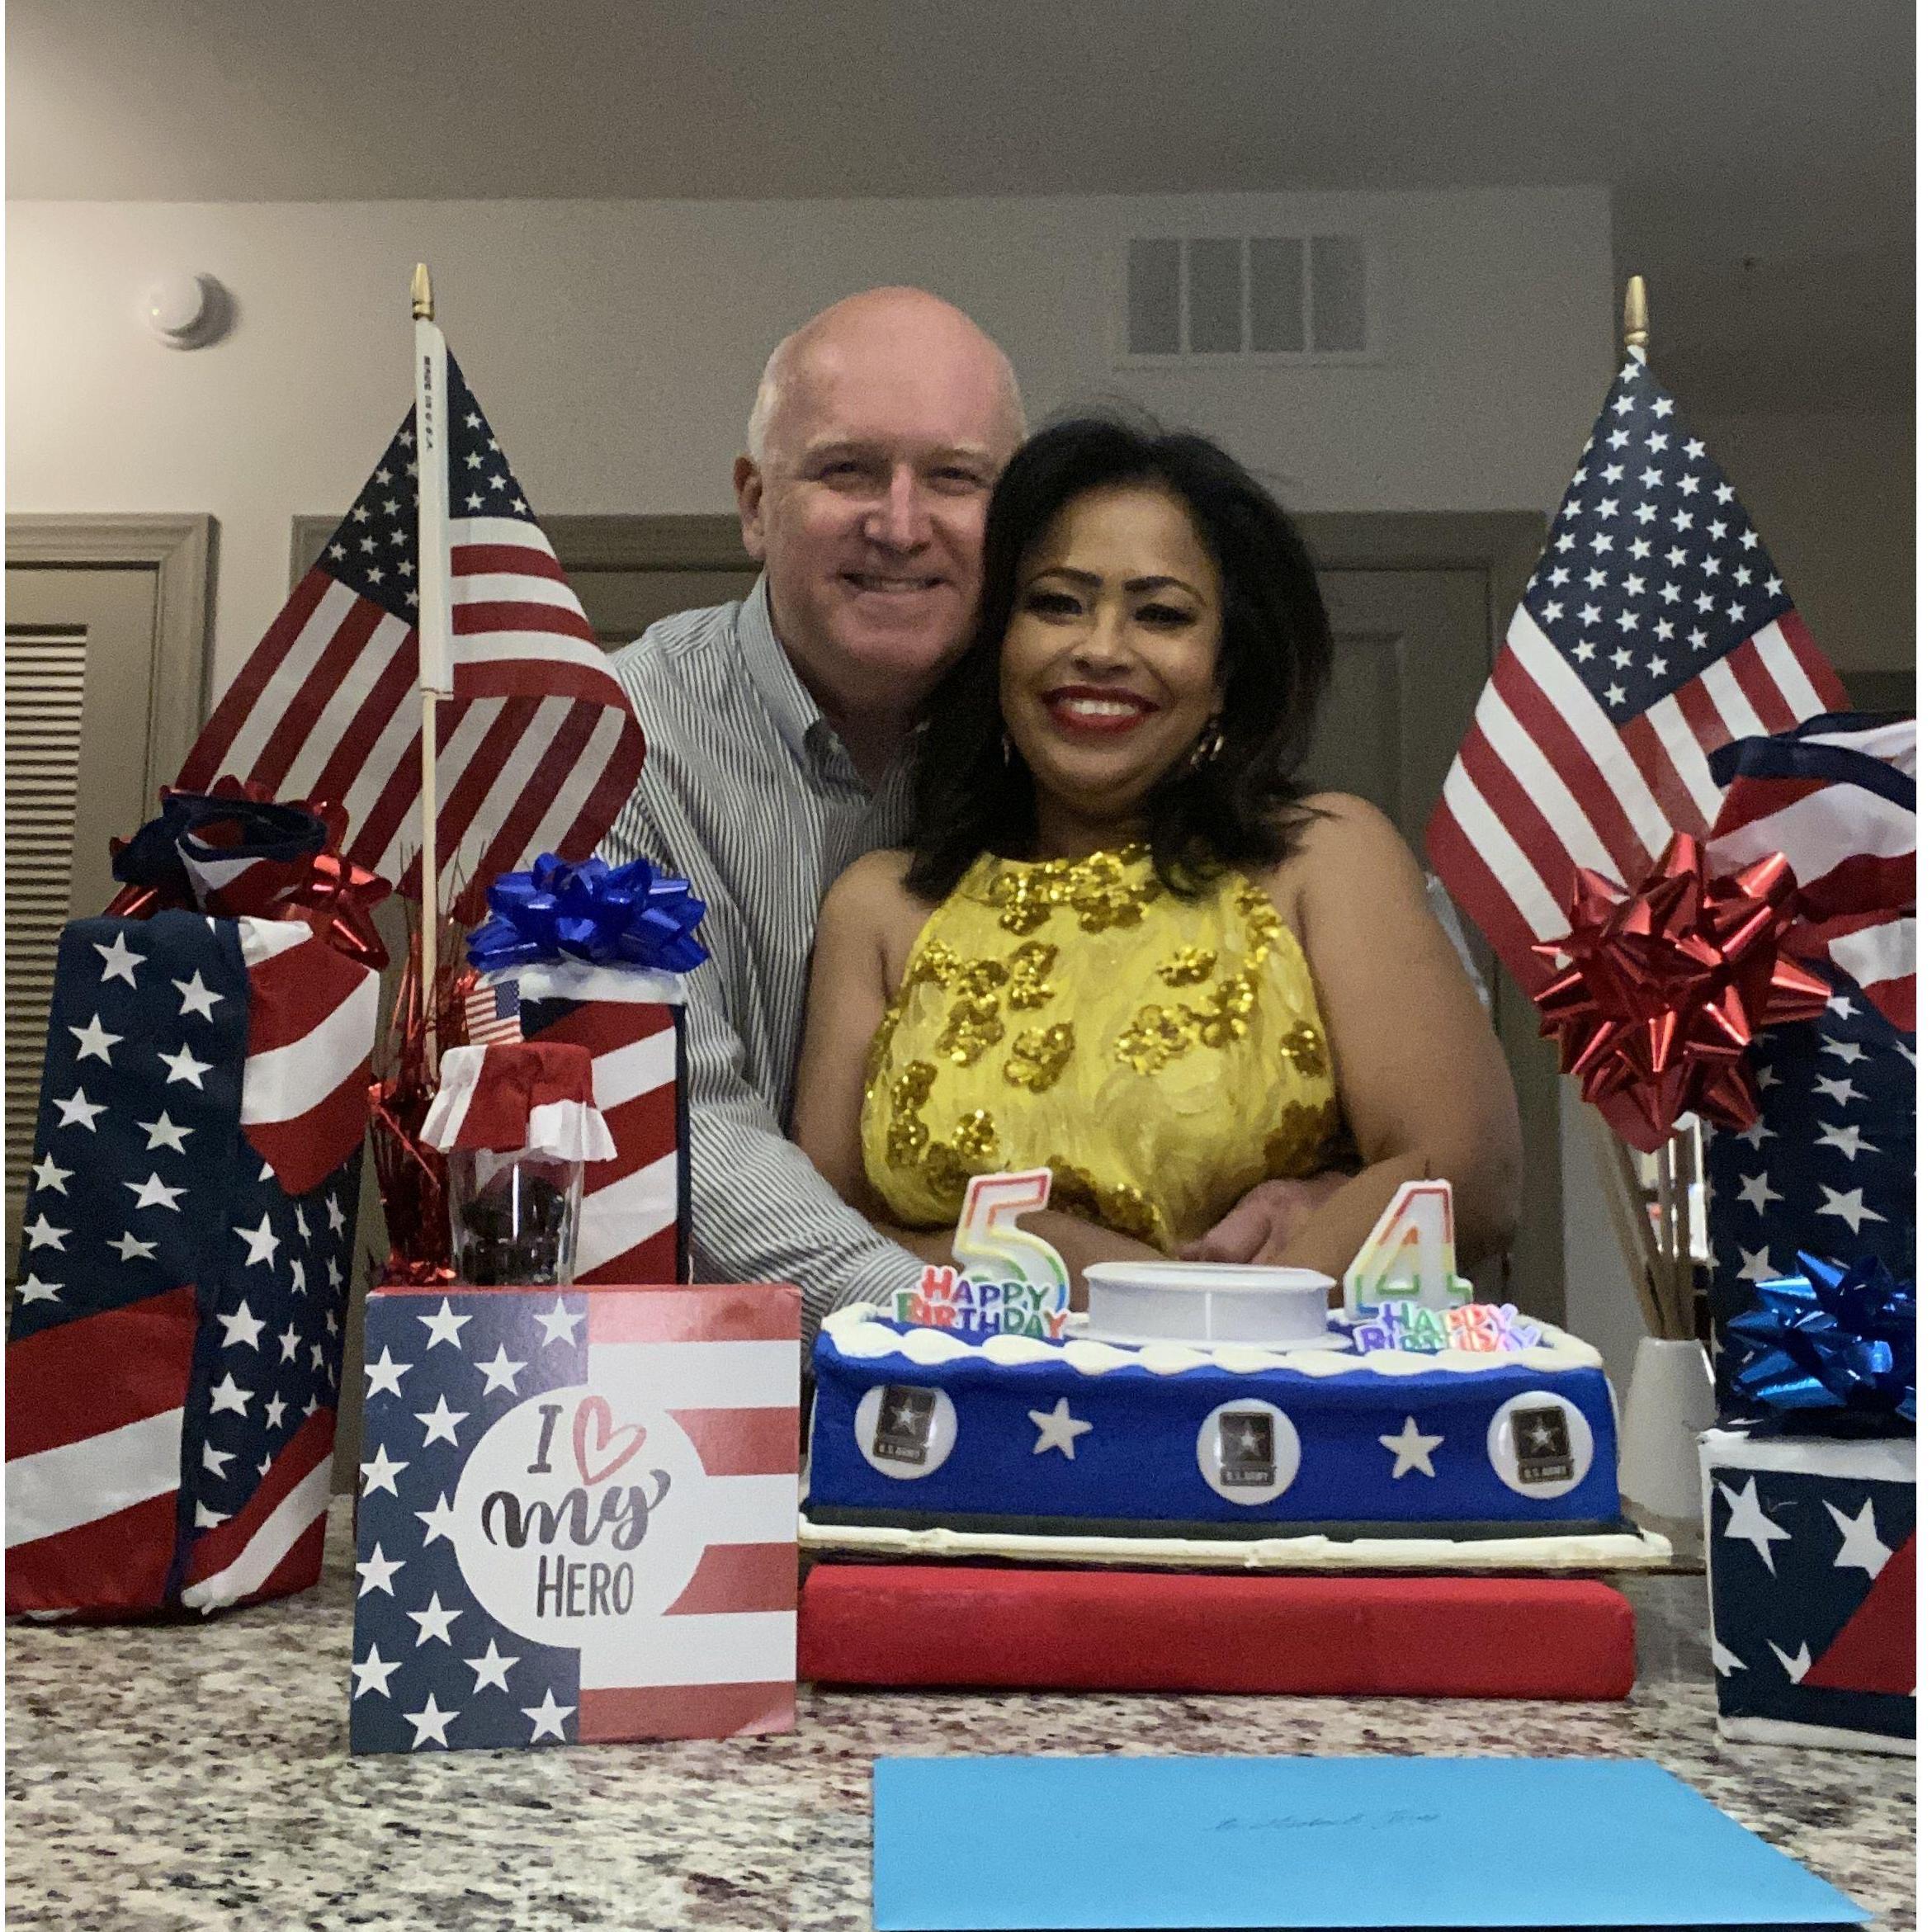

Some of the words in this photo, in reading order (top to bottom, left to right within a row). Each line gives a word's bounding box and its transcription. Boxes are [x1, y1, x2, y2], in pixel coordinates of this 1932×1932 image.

[953, 1168, 1070, 1316] 5
[1343, 1180, 1473, 1320] 4
[896, 1292, 1069, 1339] BIRTHDAY
[920, 1266, 1051, 1311] HAPPY
[526, 1404, 564, 1475] I
[480, 1468, 672, 1552] my
[536, 1554, 635, 1618] HERO
